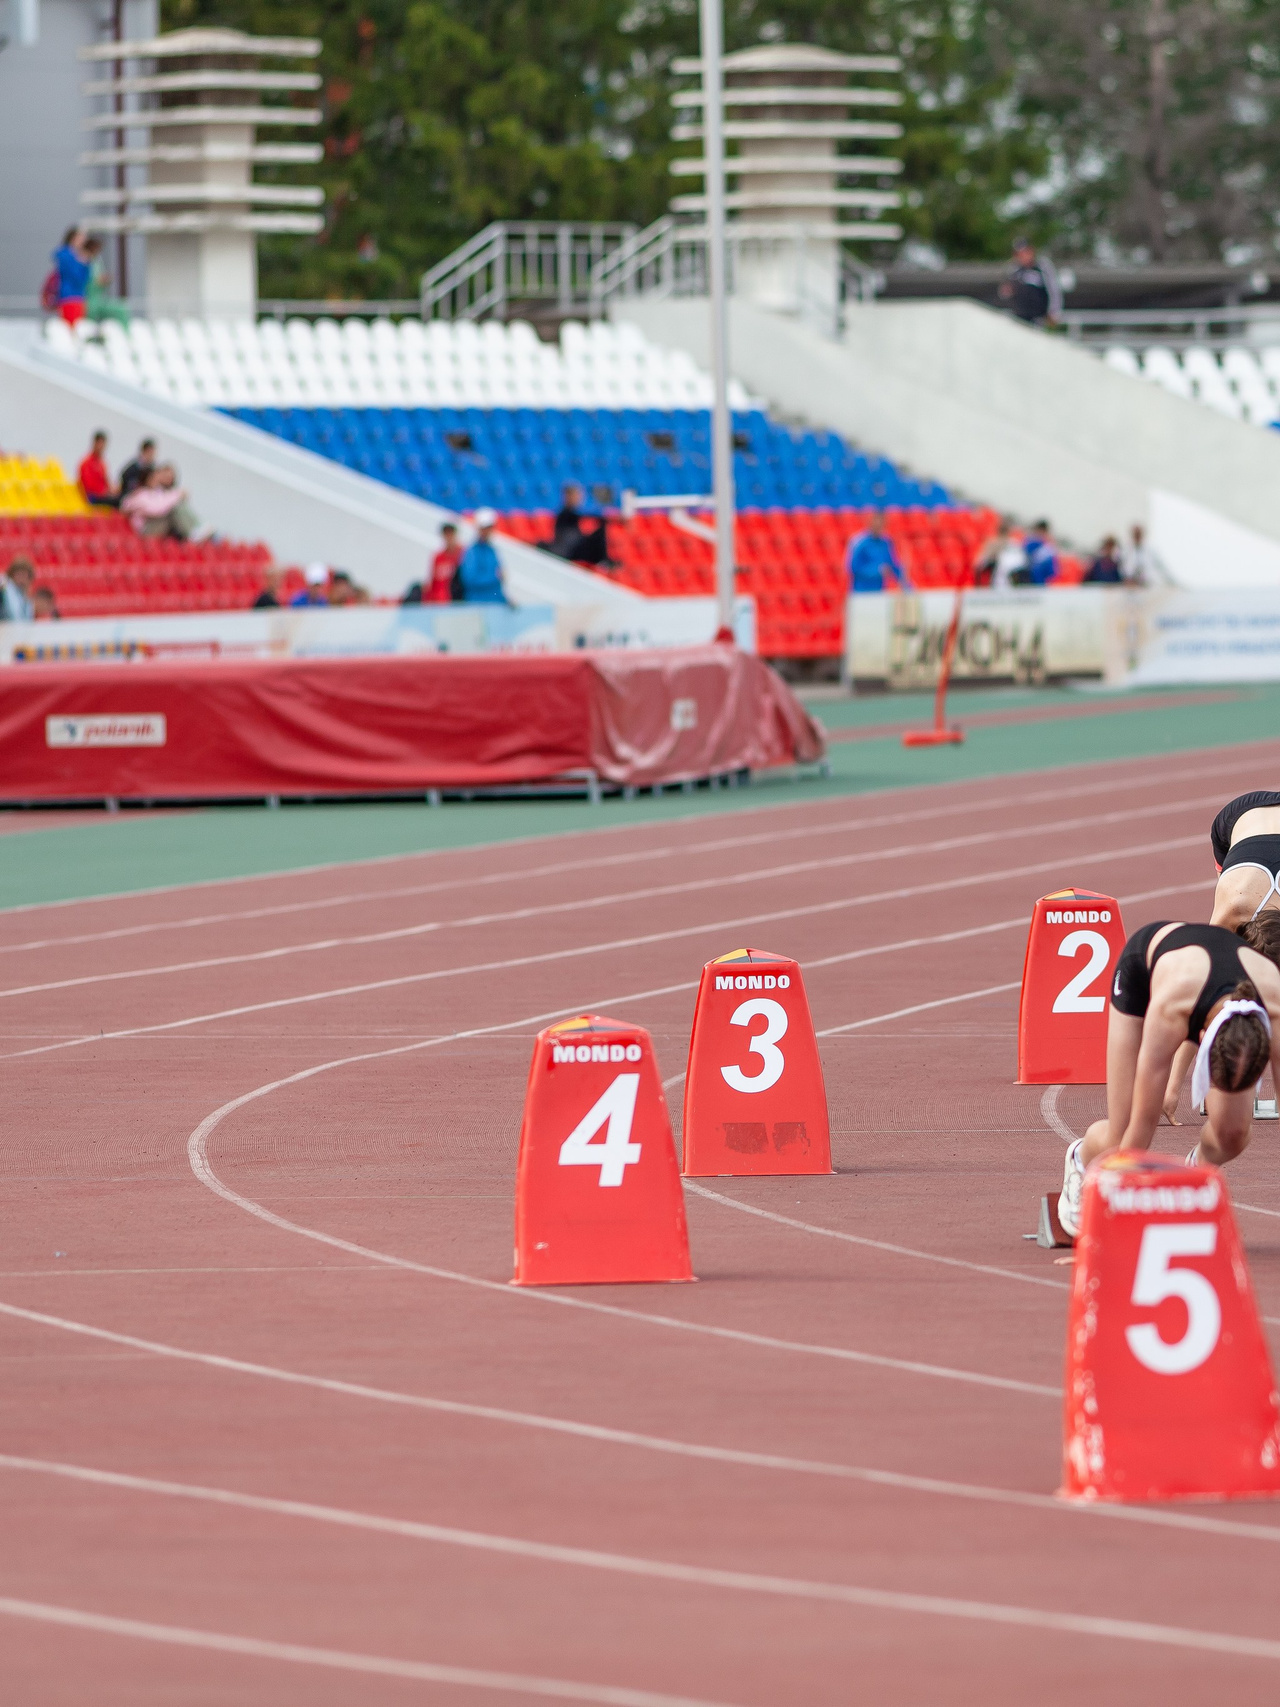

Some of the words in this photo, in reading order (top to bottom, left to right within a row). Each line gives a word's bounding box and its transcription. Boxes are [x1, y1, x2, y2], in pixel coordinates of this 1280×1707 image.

[1046, 910, 1112, 924] MONDO
[715, 974, 791, 990] MONDO
[1051, 929, 1111, 1013] 2
[552, 1044, 642, 1064] MONDO
[720, 998, 789, 1094] 3
[557, 1072, 642, 1188] 4
[1110, 1185, 1221, 1214] MONDO
[1124, 1222, 1222, 1377] 5
